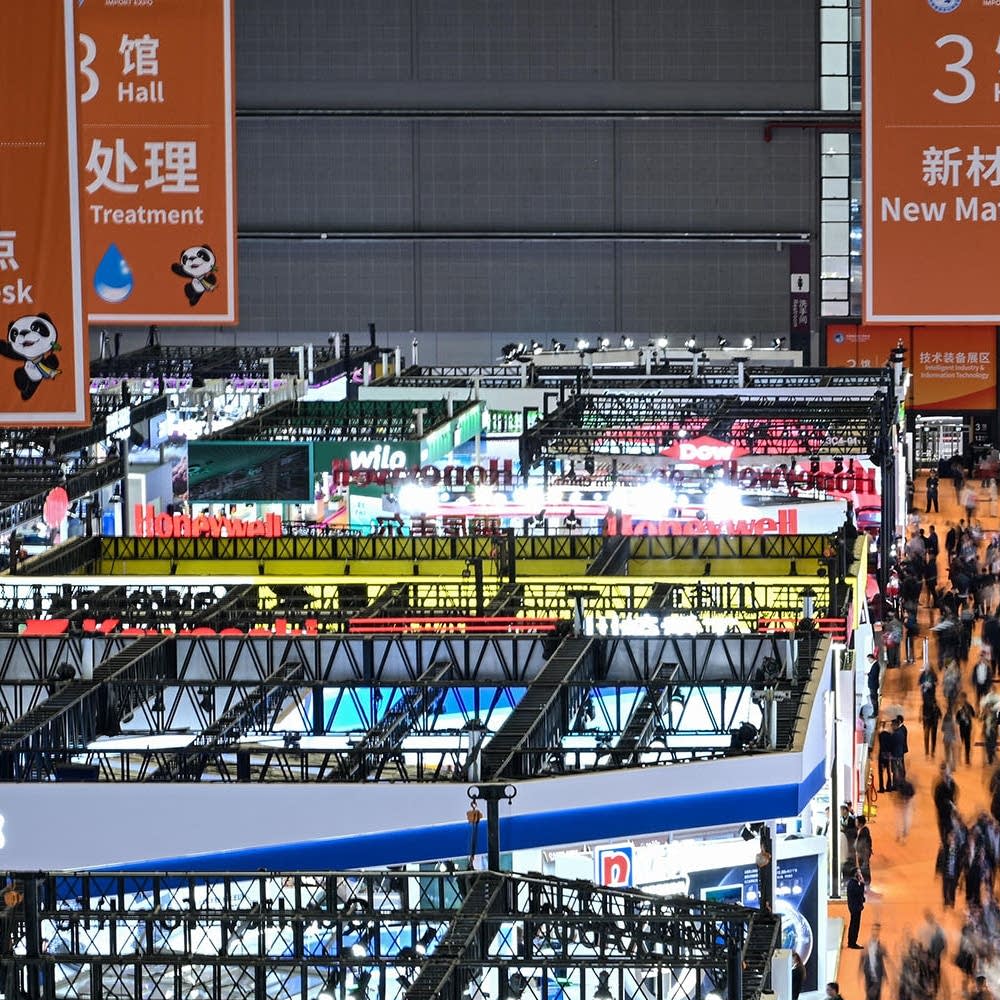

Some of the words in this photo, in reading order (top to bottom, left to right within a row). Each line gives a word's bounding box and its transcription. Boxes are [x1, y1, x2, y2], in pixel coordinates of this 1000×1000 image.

[118, 33, 160, 77] 馆
[932, 34, 976, 104] 3
[117, 81, 165, 103] Hall
[85, 138, 200, 194] 处理
[90, 204, 204, 225] Treatment
[881, 196, 946, 223] New
[0, 278, 34, 304] sk
[919, 351, 991, 364] 技术装备展区
[956, 371, 990, 381] Technology
[134, 503, 283, 538] Honeywell
